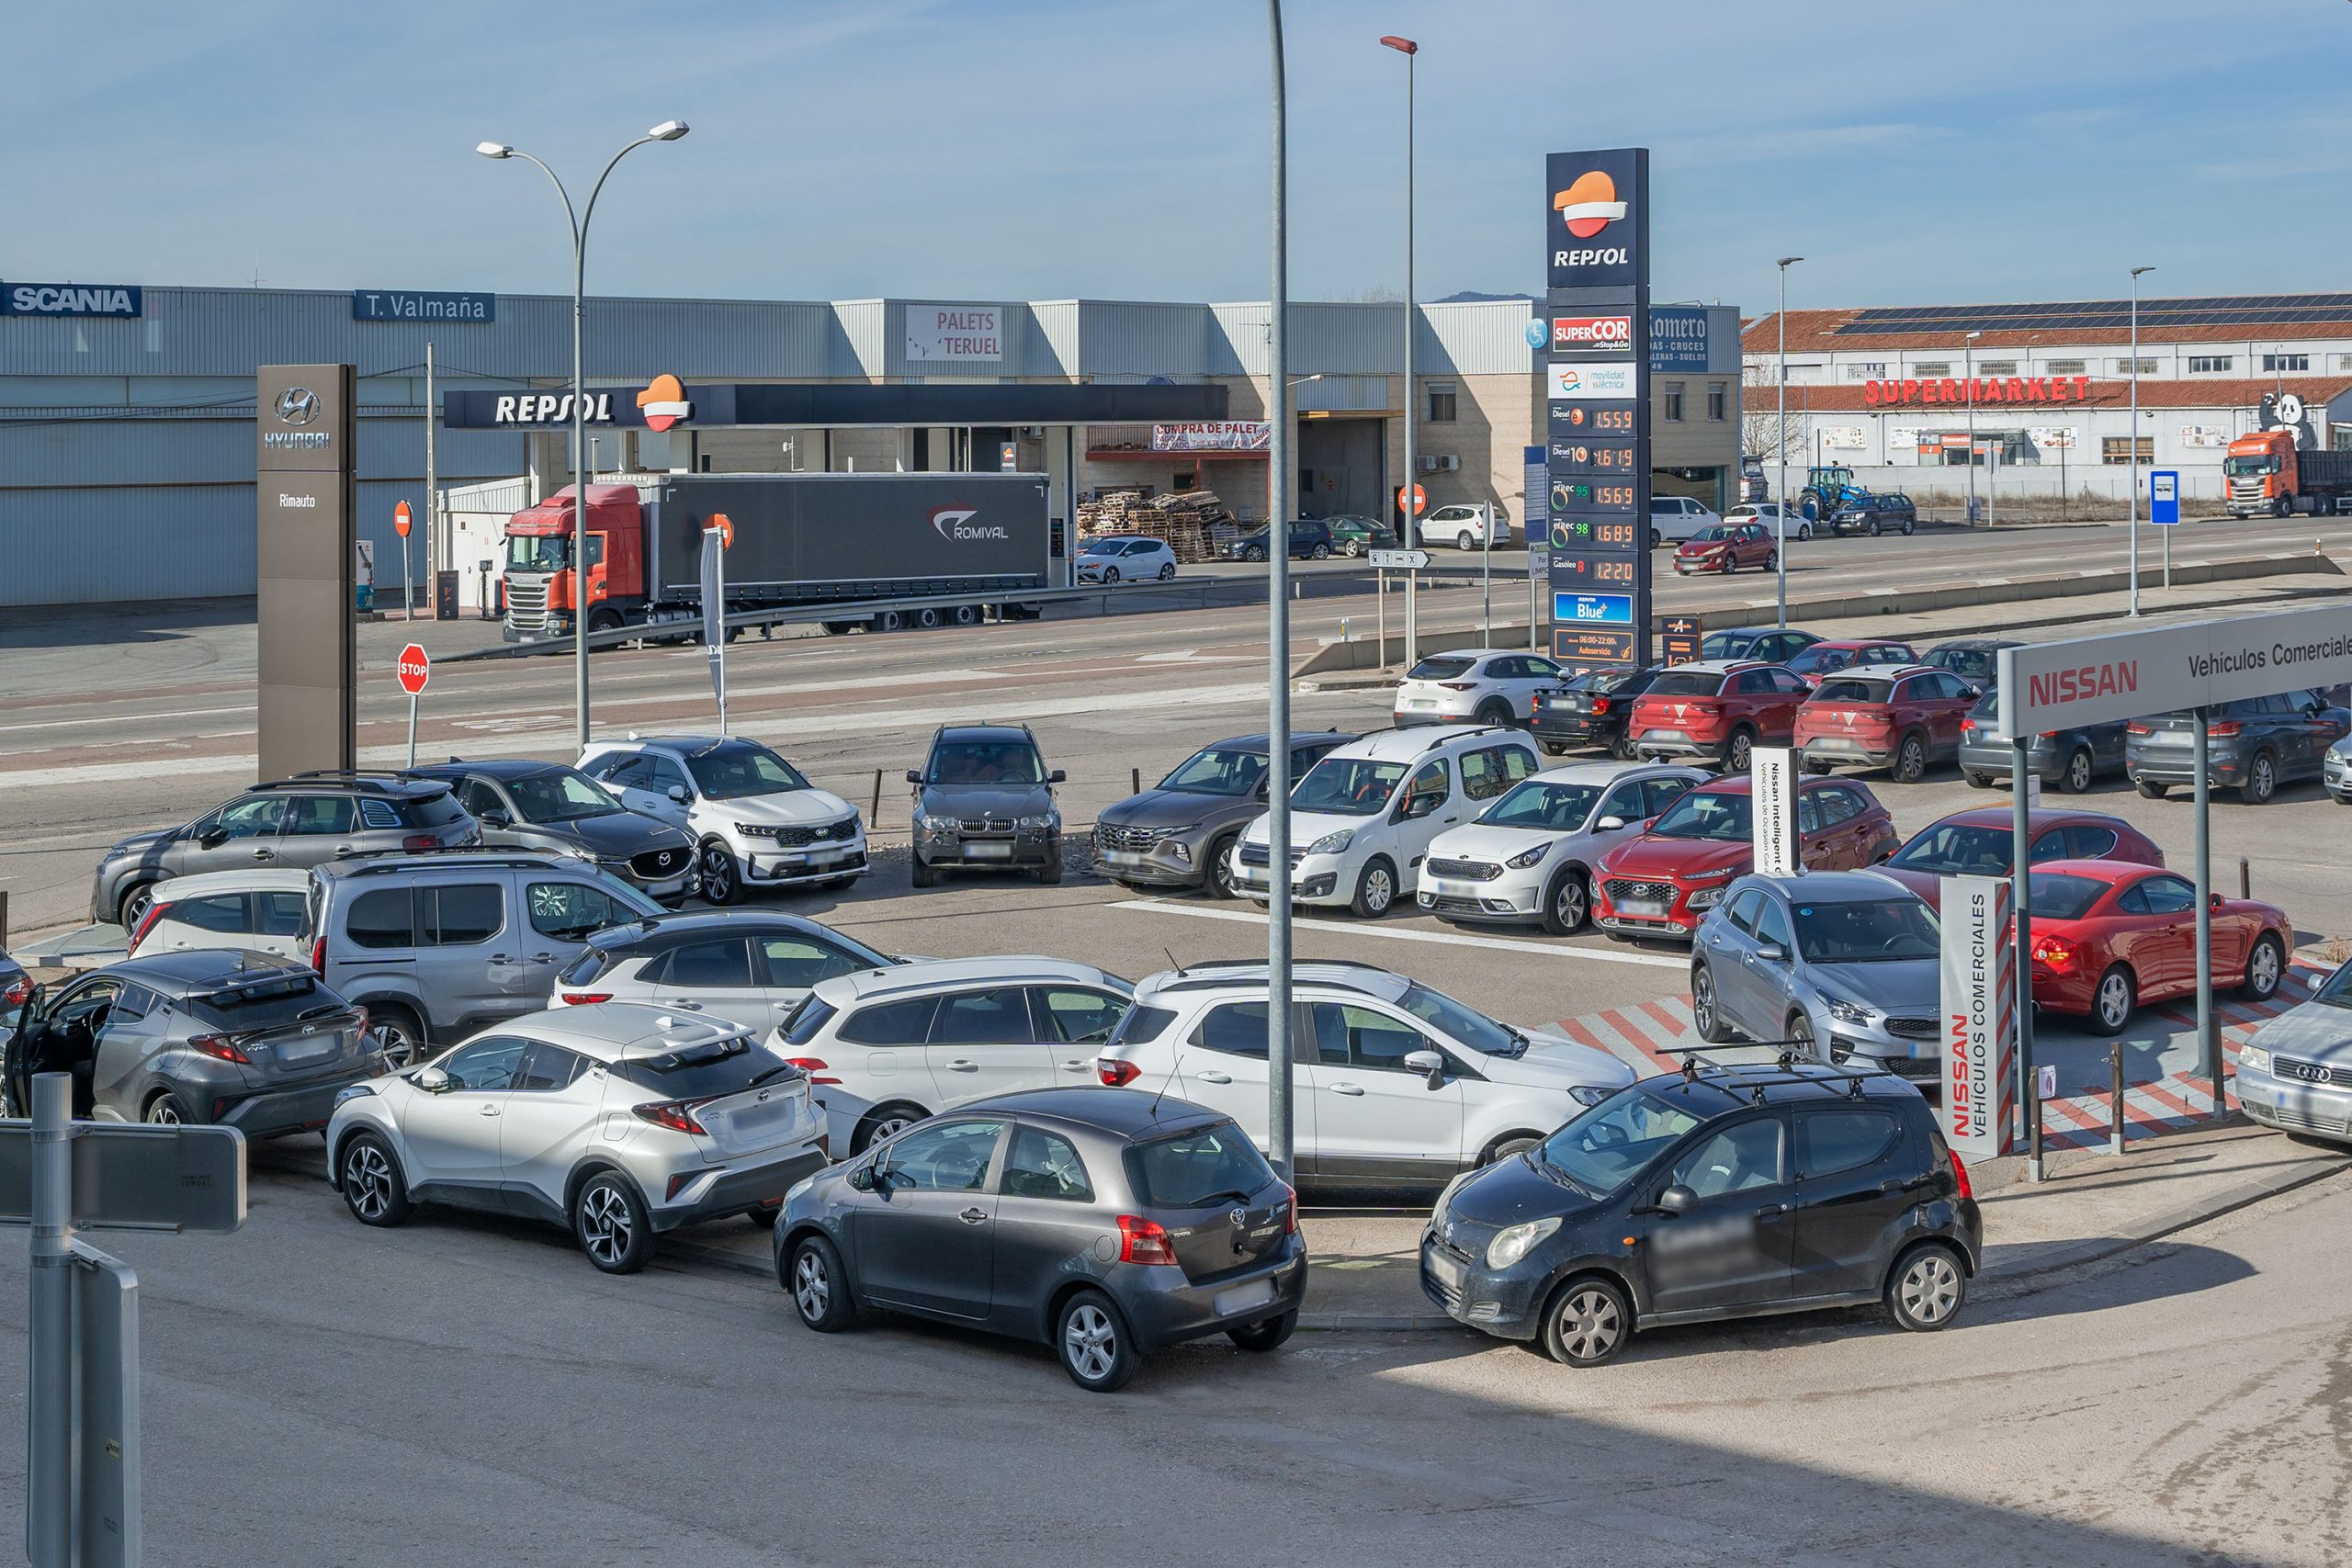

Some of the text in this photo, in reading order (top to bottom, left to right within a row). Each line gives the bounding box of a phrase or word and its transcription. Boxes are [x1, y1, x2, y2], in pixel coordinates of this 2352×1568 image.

[1555, 248, 1628, 266] REPSOL
[13, 288, 133, 312] SCANIA
[367, 295, 485, 318] T. Valmaña
[937, 312, 994, 330] PALETS
[1555, 321, 1628, 340] SUPERCOR
[944, 337, 1000, 355] TERUEL
[1670, 342, 1704, 351] CRUCES
[1590, 370, 1624, 379] movilidad
[1865, 376, 2089, 404] SUPERMARKET
[495, 393, 611, 422] REPSOL
[1553, 410, 1570, 418] Diesel
[1156, 423, 1259, 434] COMPRA DE PALET
[265, 433, 330, 449] HYUNDAI
[1553, 447, 1570, 456] Diesel
[1576, 485, 1589, 497] 95
[279, 493, 316, 507] Rimauto
[954, 526, 1009, 539] ROMIVAL
[1576, 523, 1589, 534] 98
[1553, 559, 1577, 569] Gasóleo
[1577, 560, 1585, 573] B
[1578, 646, 1611, 656] Autoservicio
[401, 662, 426, 677] STOP
[2188, 647, 2266, 678] Vehículos
[2030, 660, 2137, 707] NISSAN
[1762, 805, 1769, 815] de
[1772, 805, 1781, 863] Intelligent
[1972, 893, 1986, 1138] VEHÍCULOS COMERCIALES
[1952, 1014, 1970, 1137] NISSAN
